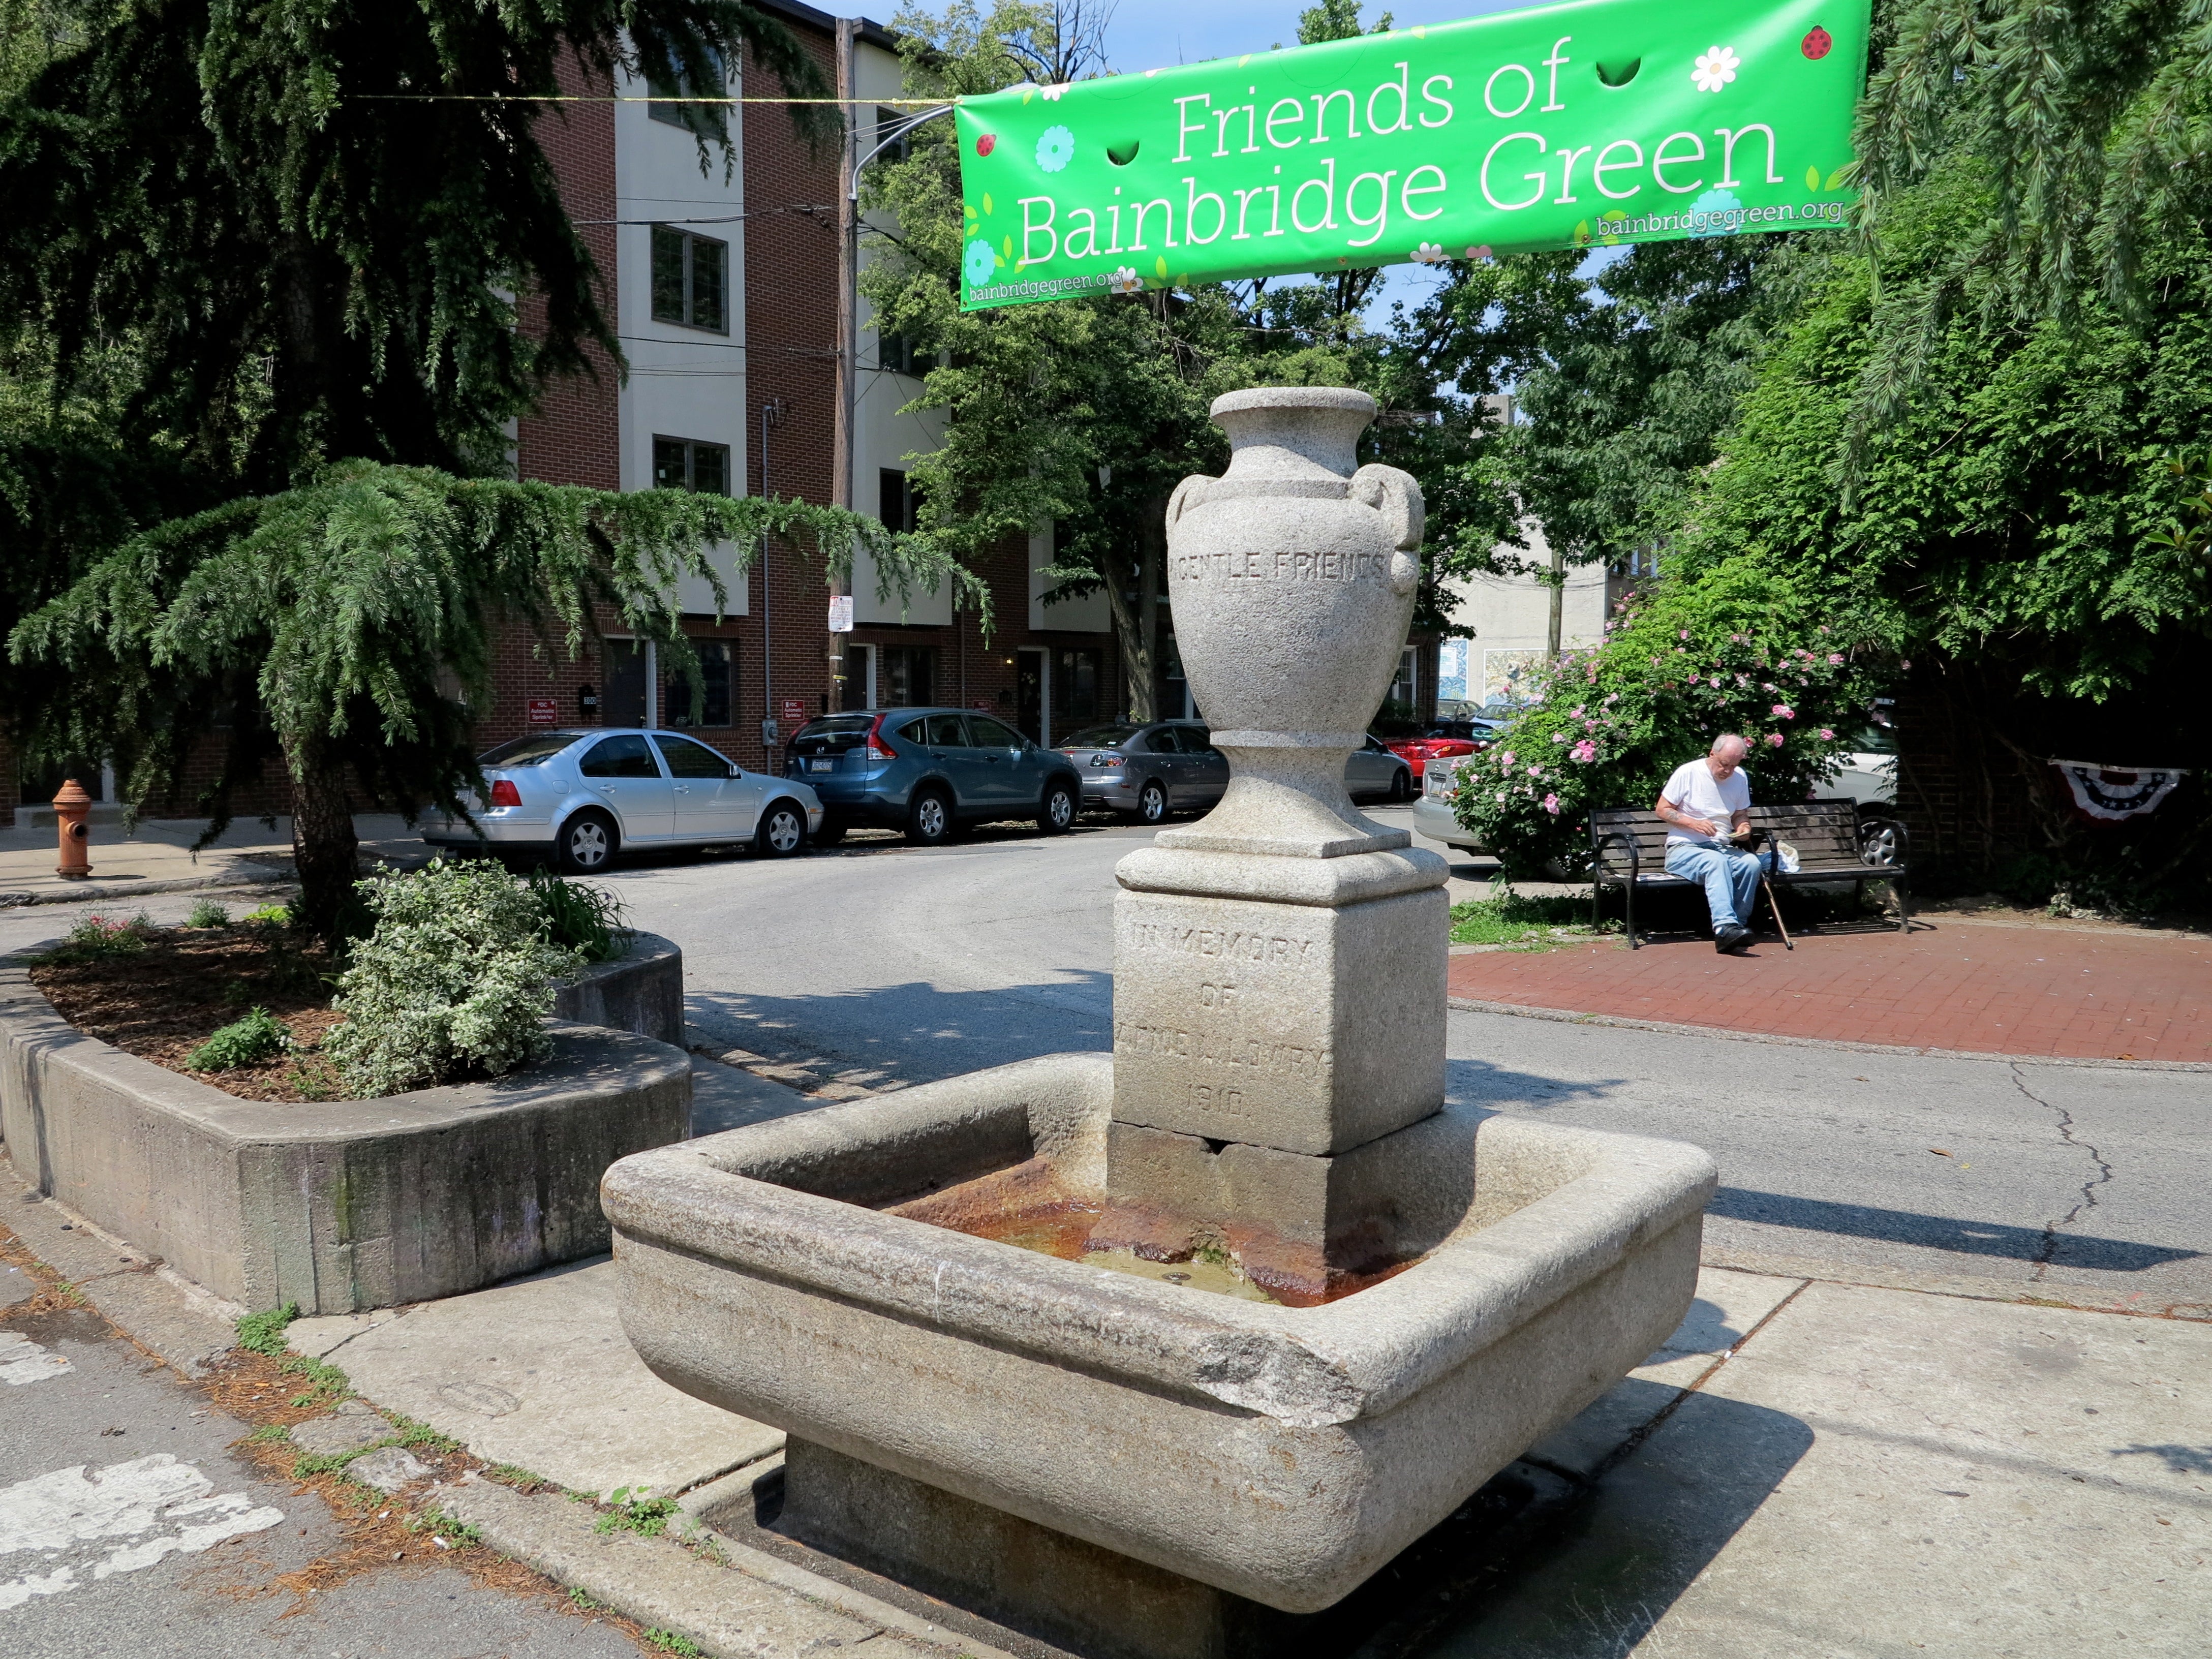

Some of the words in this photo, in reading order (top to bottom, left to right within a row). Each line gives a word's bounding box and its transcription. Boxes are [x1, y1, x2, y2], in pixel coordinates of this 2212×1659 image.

[1172, 61, 1453, 163] Friends
[1484, 36, 1572, 118] of
[1018, 158, 1447, 265] Bainbridge
[1480, 123, 1784, 210] Green
[1596, 201, 1844, 236] bainbridgegreen.org
[968, 270, 1125, 302] bainbridgegreen.org
[1179, 552, 1261, 580] GENTLE
[1275, 551, 1386, 580] FRIENDS
[830, 598, 838, 606] NO
[1174, 928, 1313, 966] MEMORY
[1201, 983, 1235, 1007] OF
